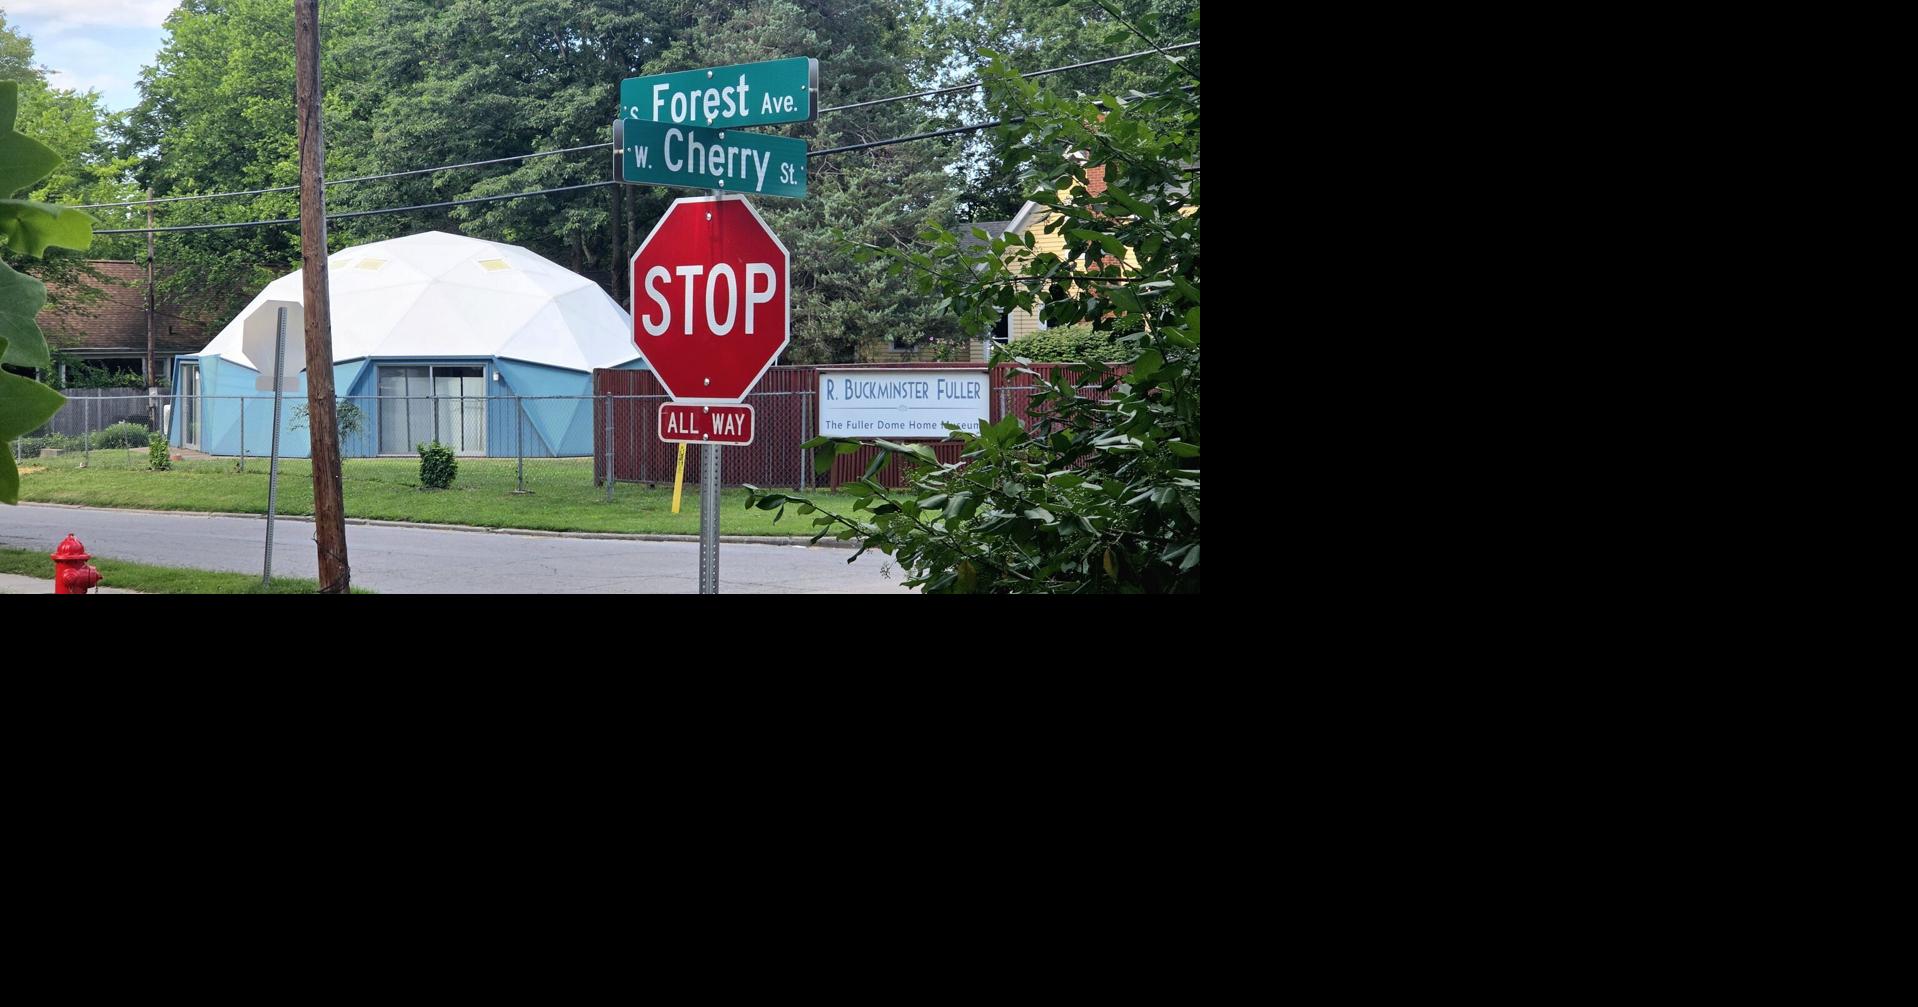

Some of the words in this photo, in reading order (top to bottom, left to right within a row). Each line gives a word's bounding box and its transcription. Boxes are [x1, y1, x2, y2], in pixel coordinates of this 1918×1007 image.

[653, 74, 749, 123] Forest
[761, 93, 798, 115] Ave.
[635, 145, 652, 169] W.
[664, 128, 770, 192] Cherry
[780, 162, 798, 185] St.
[642, 263, 777, 337] STOP
[827, 379, 838, 400] R.
[845, 379, 929, 400] BUCKMINSTER
[937, 379, 981, 400] FULLER
[667, 412, 699, 434] ALL
[712, 413, 745, 436] WAY
[826, 421, 843, 430] The
[847, 421, 873, 430] Fuller
[878, 421, 905, 430] Dome
[909, 421, 937, 430] Home
